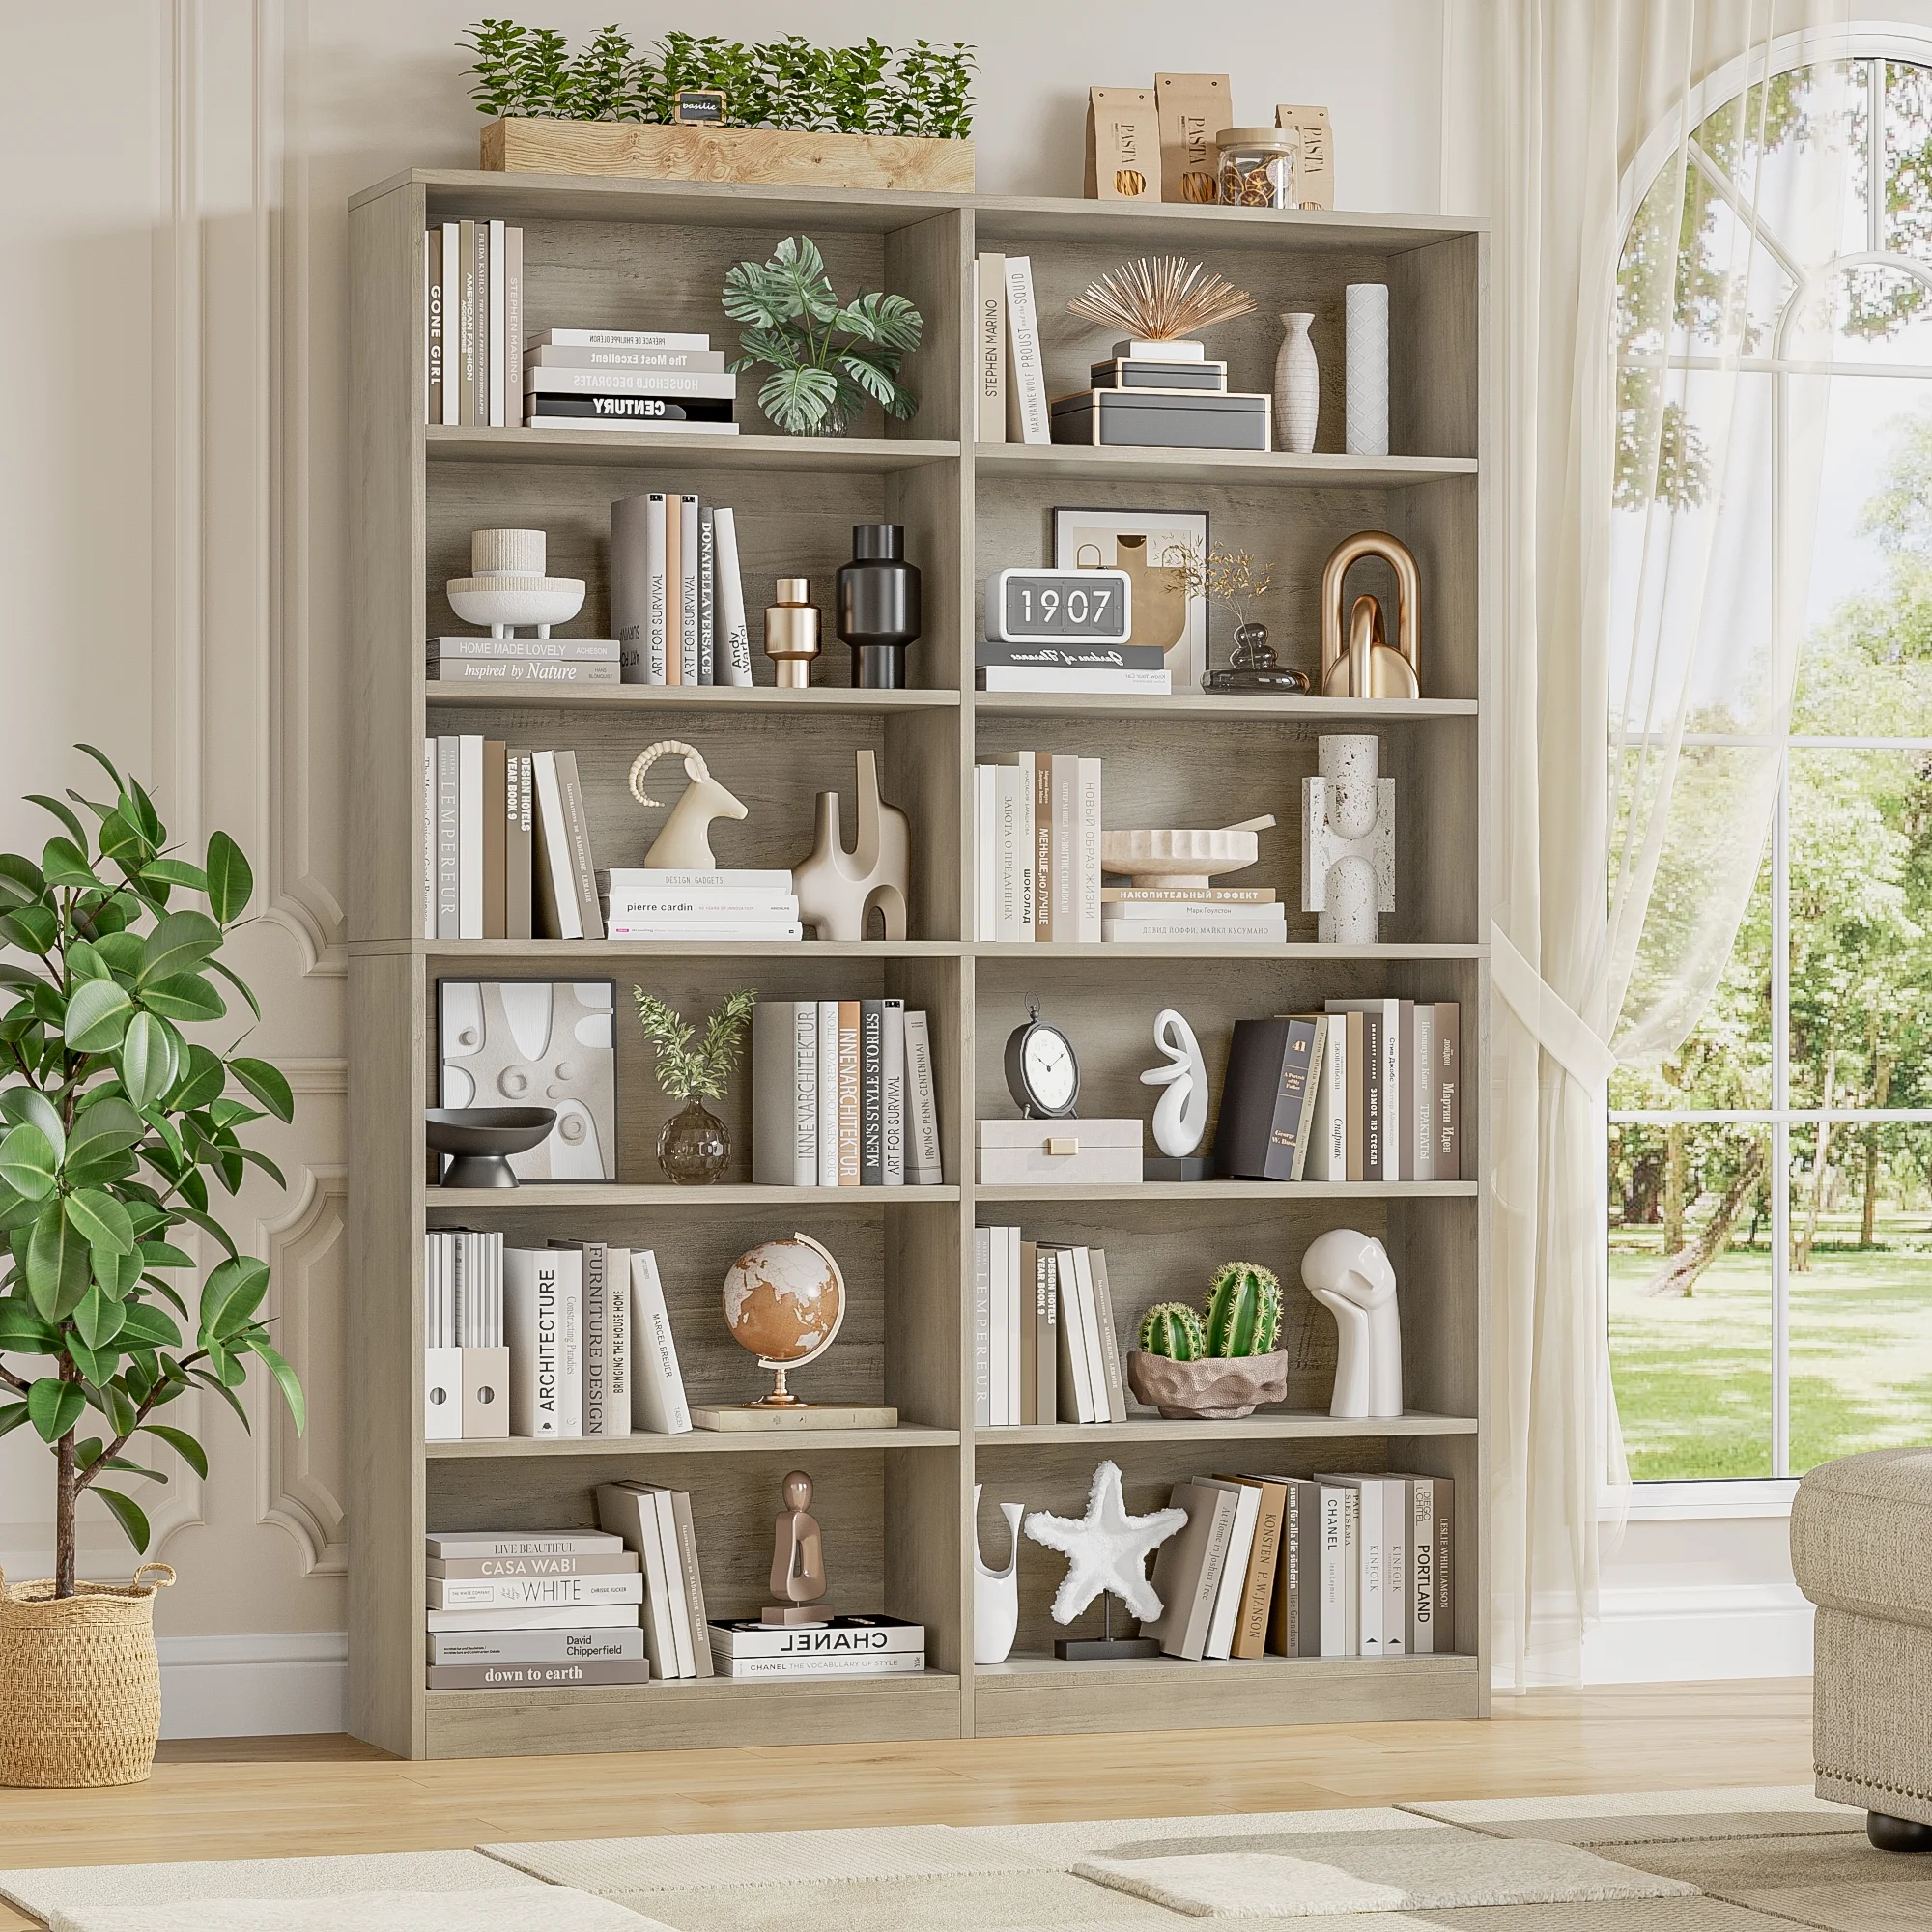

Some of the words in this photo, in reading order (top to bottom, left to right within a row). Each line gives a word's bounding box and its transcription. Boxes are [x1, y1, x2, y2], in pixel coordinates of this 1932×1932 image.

[1121, 124, 1136, 164] PASTA
[1188, 115, 1207, 165] PASTA
[1303, 127, 1324, 174] PASTA
[1011, 273, 1028, 305] SQUID
[431, 285, 441, 338] GONE
[985, 299, 998, 345] MARINO
[431, 345, 441, 385] GIRL
[1017, 327, 1035, 368] PROUST
[985, 347, 998, 397] STEPHEN
[701, 522, 712, 608] DONATELLA
[652, 574, 663, 625] SURVIVAL
[684, 575, 695, 626] SURVIVAL
[1021, 589, 1112, 624] 1907
[459, 641, 492, 654] HOME
[494, 643, 524, 655] MADE
[526, 643, 566, 656] LOVELY
[652, 629, 663, 651] FOR
[684, 629, 695, 652] FOR
[701, 610, 713, 675] VERSACE
[728, 631, 742, 668] Andy
[737, 624, 750, 674] Warhol
[464, 664, 506, 677] Inspired
[511, 664, 524, 679] by
[526, 662, 577, 680] Nature
[652, 656, 663, 677] ART
[684, 657, 695, 678] ART
[507, 756, 518, 783] YEAR
[521, 757, 531, 793] DESIGN
[507, 784, 518, 811] BOOK
[521, 795, 531, 832] HOTELS
[1085, 782, 1096, 827] НОВЫЙ
[1004, 796, 1013, 837] ЗАБОТА
[440, 781, 456, 915] LEMPEREUR
[1004, 840, 1013, 849] О
[1085, 831, 1094, 870] ОБРАЗ
[575, 835, 587, 872] MADELEINE
[581, 874, 592, 903] LEMAIRE
[694, 876, 724, 885] GADGETS
[1003, 851, 1013, 921] ПРЕДАННЫХ
[627, 903, 658, 912] pierre
[1038, 889, 1049, 925] ЛУЧШЕ
[1085, 873, 1094, 919] ЖИЗНИ
[1120, 890, 1212, 899] НАКОПИТЕЛЬНЫЙ
[1216, 891, 1259, 899] ЭФФЕКТ
[1142, 926, 1167, 935] ДЭВИД
[1200, 925, 1226, 934] МАЙКЛ
[826, 1010, 837, 1083] REVOLUTION
[866, 1012, 880, 1075] STORIES
[1292, 1040, 1307, 1053] 41
[1420, 1020, 1431, 1065] Иммануил
[797, 1011, 815, 1159] INNENARCHITEKTUR
[915, 1042, 929, 1097] CENTENNIAL
[1421, 1067, 1430, 1090] Кант
[826, 1086, 837, 1117] LOOK
[839, 1028, 858, 1177] INNENARCHITEKTUR
[866, 1076, 880, 1121] STYLE
[887, 1076, 900, 1125] SURVIVAL
[920, 1098, 931, 1124] PENN:
[1440, 1082, 1455, 1122] Мартин
[826, 1119, 837, 1145] NEW
[887, 1128, 900, 1152] FOR
[923, 1126, 935, 1160] IRVING
[1274, 1129, 1295, 1139] George
[1420, 1104, 1430, 1160] ТРАКТАТЫ
[1441, 1126, 1455, 1153] Иден
[887, 1155, 900, 1175] ART
[1037, 1256, 1046, 1280] YEAR
[1047, 1257, 1056, 1291] DESIGN
[588, 1246, 603, 1358] FURNITURE
[613, 1290, 624, 1312] HOME
[1037, 1282, 1046, 1307] BOOK
[1047, 1292, 1056, 1325] HOTELS
[564, 1295, 577, 1343] Constructing
[613, 1314, 624, 1339] HOUSE
[539, 1269, 554, 1412] ARCHITECTURE
[613, 1340, 624, 1355] THE
[652, 1313, 666, 1346] MARCEL
[659, 1346, 673, 1378] BREUER
[976, 1272, 988, 1403] LEMPEREUR
[613, 1357, 624, 1394] BRINGING
[588, 1363, 603, 1435] DESIGN
[1221, 1506, 1231, 1517] At
[1290, 1509, 1299, 1521] für
[1415, 1486, 1424, 1527] UCHITEL
[1423, 1492, 1432, 1521] DIEGO
[1215, 1519, 1229, 1543] Home
[1260, 1513, 1277, 1565] KONSTEN
[1290, 1523, 1299, 1538] alla
[1327, 1499, 1338, 1551] CHANEL
[1439, 1518, 1449, 1546] LESLIE
[494, 1543, 518, 1555] LIVE
[519, 1541, 576, 1554] BEAUTIFUL
[1212, 1544, 1223, 1552] in
[1290, 1540, 1299, 1552] die
[480, 1560, 526, 1576] CASA
[530, 1557, 577, 1574] WABI
[1206, 1552, 1220, 1581] Joshua
[1290, 1554, 1299, 1589] sünderin
[1370, 1545, 1378, 1593] KINFOLK
[1392, 1545, 1402, 1593] KINFOLK
[1417, 1545, 1431, 1623] PORTLAND
[521, 1579, 581, 1602] WHITE
[1202, 1583, 1214, 1601] Tree
[1290, 1594, 1298, 1608] lise
[689, 1575, 699, 1611] MADELEINE
[695, 1613, 704, 1642] LEMAIRE
[566, 1635, 592, 1645] David
[1290, 1609, 1298, 1648] Grandsun
[566, 1645, 622, 1659] Chipperfield
[806, 1661, 860, 1669] VOCABULARY
[484, 1668, 523, 1683] down
[526, 1668, 541, 1682] to
[544, 1666, 583, 1681] earth
